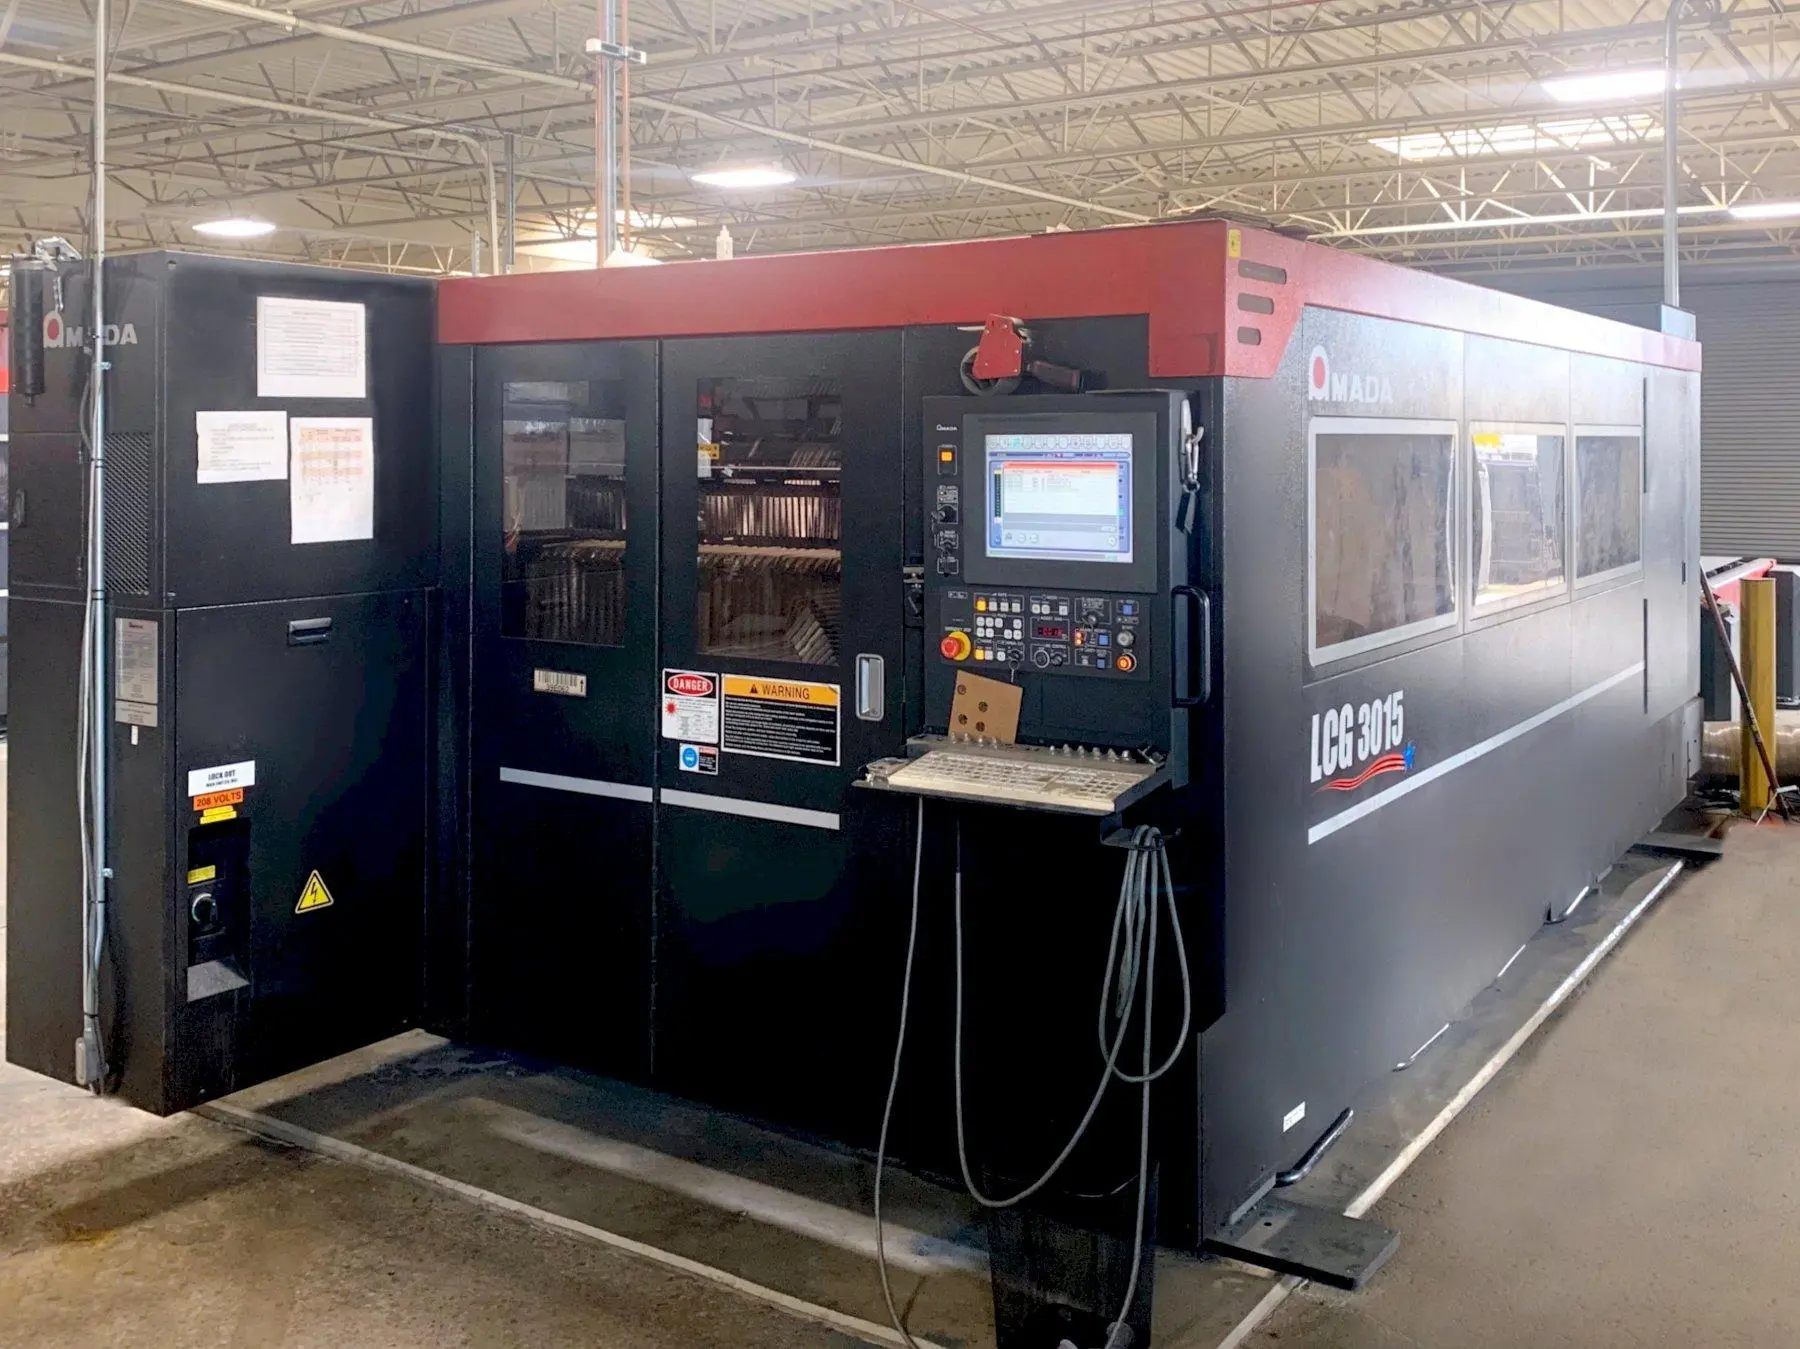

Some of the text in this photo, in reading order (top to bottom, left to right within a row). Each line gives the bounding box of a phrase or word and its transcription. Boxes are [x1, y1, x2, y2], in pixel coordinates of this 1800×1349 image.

[43, 310, 138, 349] AMDA
[1308, 344, 1394, 403] AMADA
[673, 678, 709, 692] DANGER
[761, 684, 810, 700] WARNING
[1310, 690, 1404, 783] LCG 3015
[208, 769, 236, 781] LOCK OUT
[196, 791, 241, 808] 208 VOLTS
